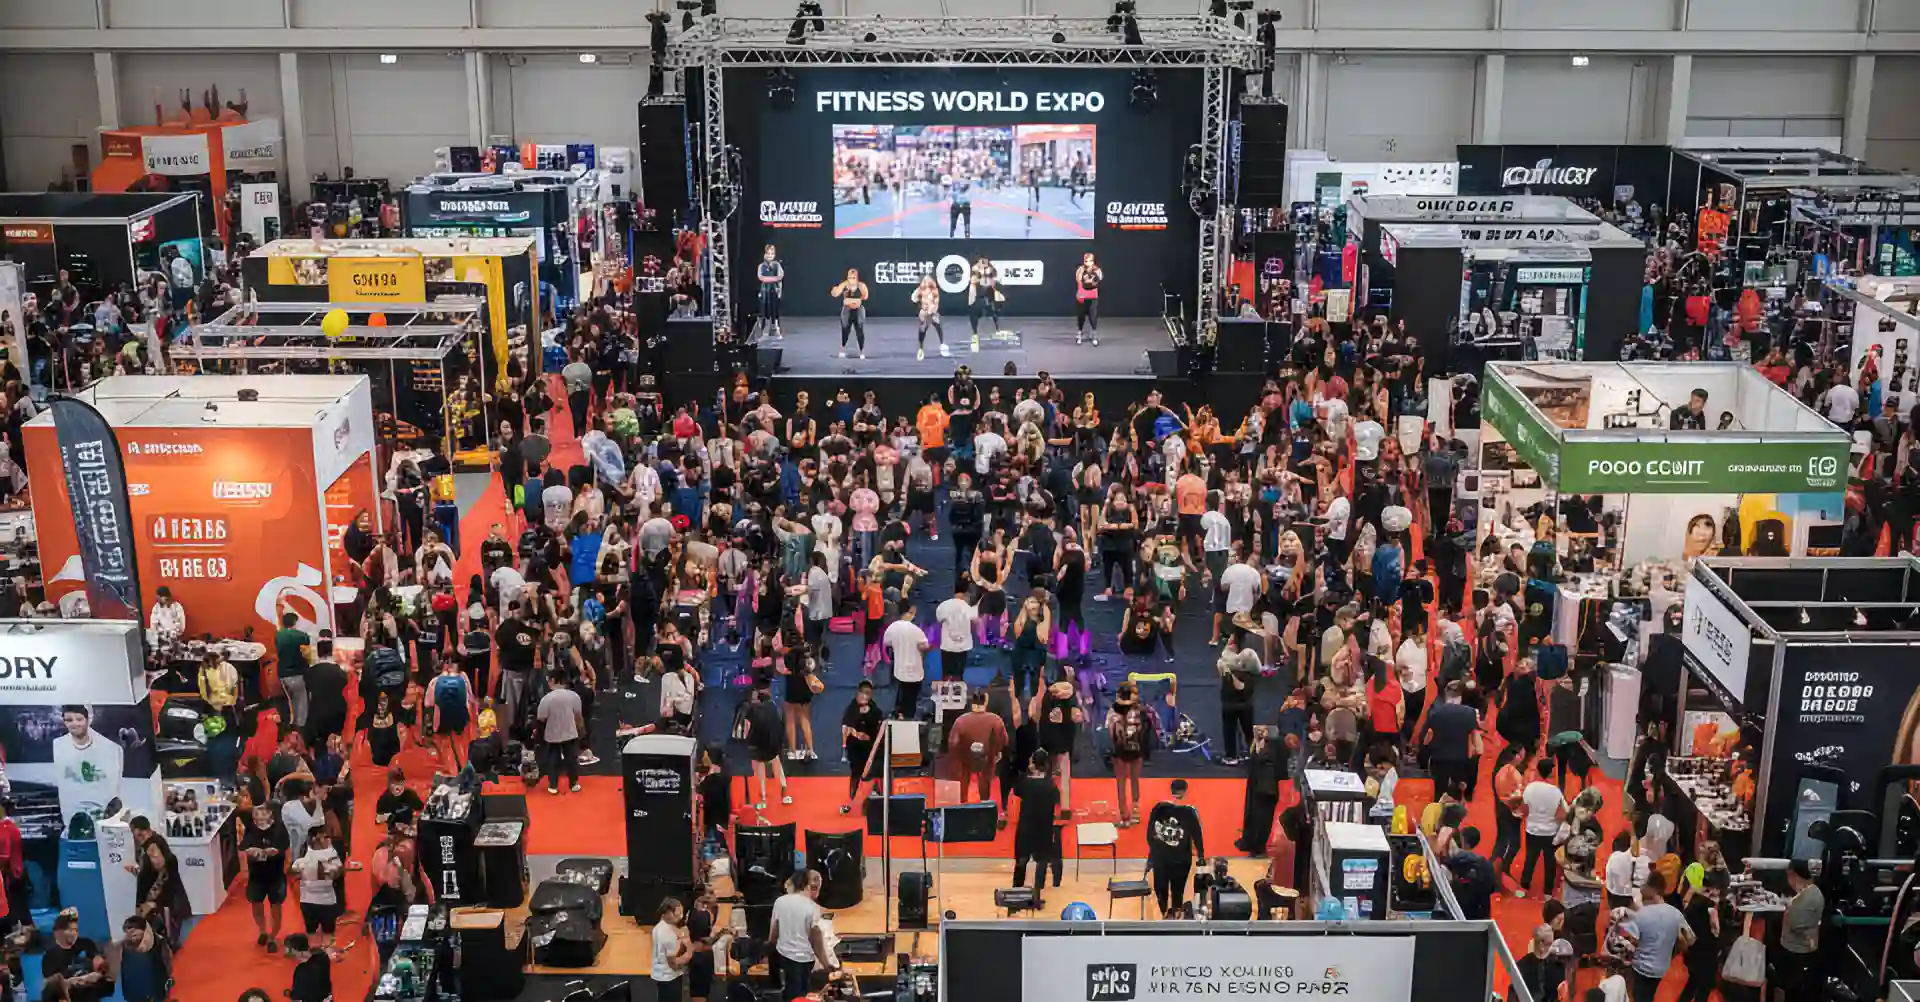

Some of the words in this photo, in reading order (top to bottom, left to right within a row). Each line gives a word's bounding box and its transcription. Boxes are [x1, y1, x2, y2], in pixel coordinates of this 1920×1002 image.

[816, 91, 925, 112] FITNESS
[931, 91, 1028, 112] WORLD
[1036, 91, 1105, 113] EXPO
